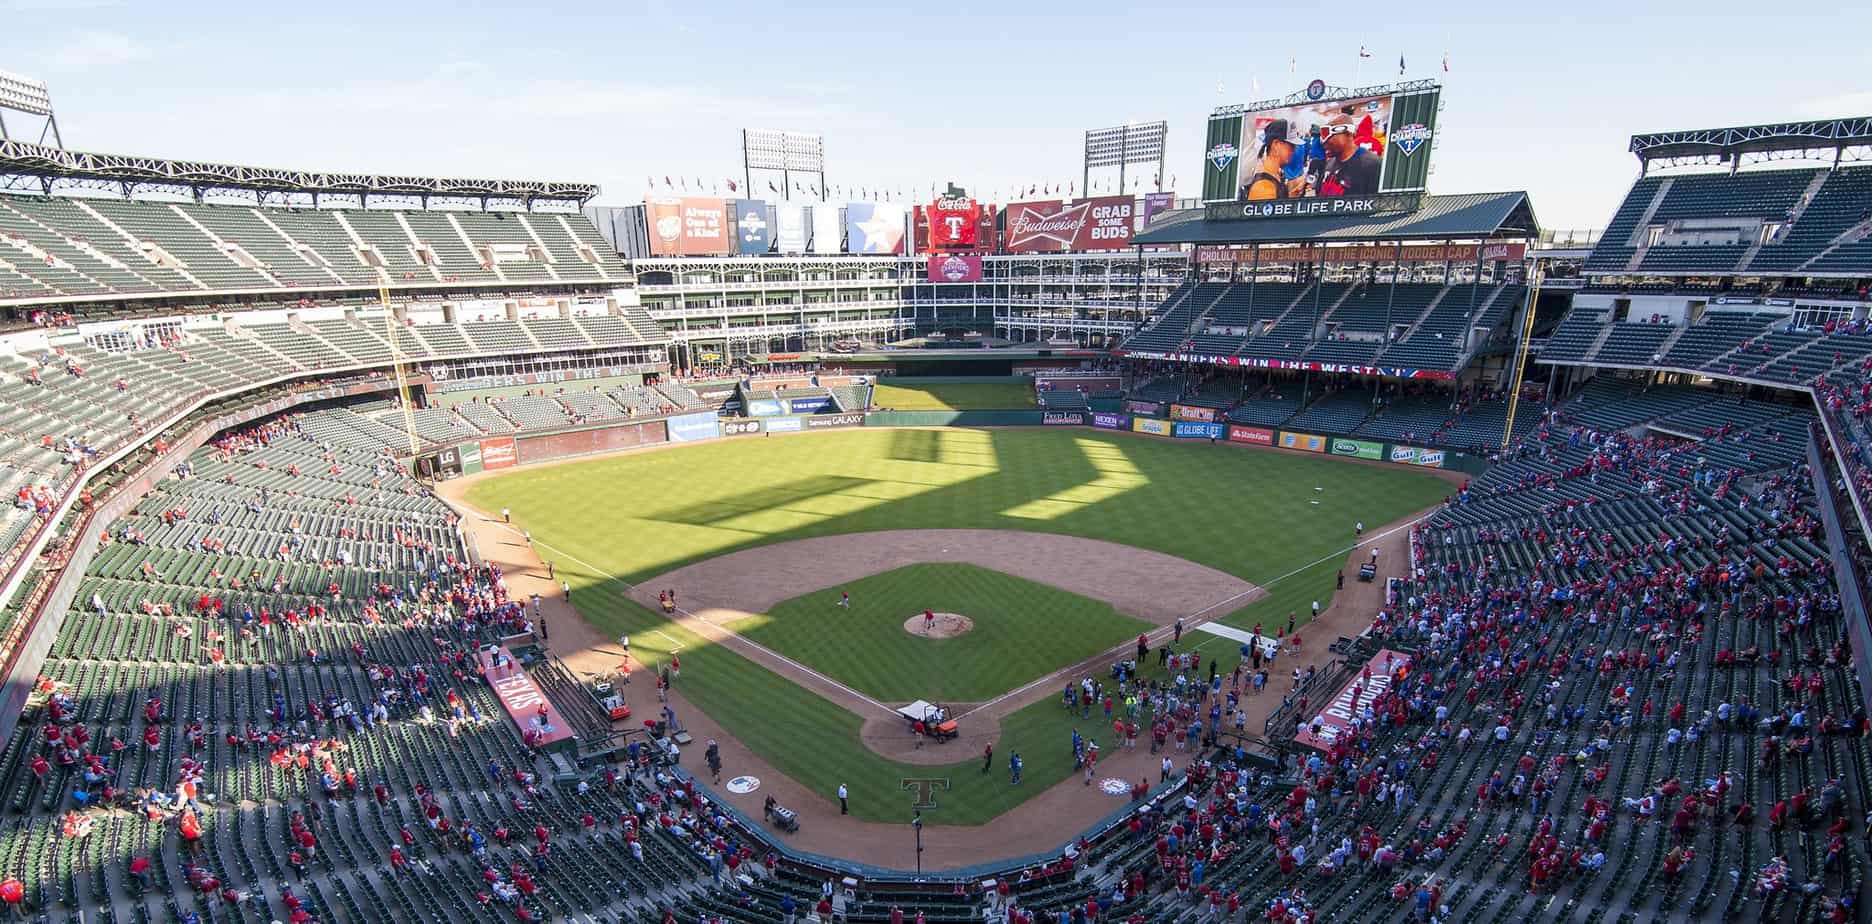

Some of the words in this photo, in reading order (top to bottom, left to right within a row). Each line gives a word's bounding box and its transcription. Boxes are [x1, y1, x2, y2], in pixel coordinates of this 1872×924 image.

[937, 196, 972, 211] Coca-Cola
[1243, 203, 1292, 217] GLOBE
[1297, 201, 1328, 214] LIFE
[1333, 199, 1374, 212] PARK
[685, 208, 720, 219] Always
[1091, 205, 1131, 219] GRAB
[686, 218, 706, 227] One
[945, 216, 963, 239] T
[1010, 216, 1086, 234] Budweiser
[1098, 218, 1124, 227] SOME
[695, 228, 720, 237] Kind
[1091, 226, 1129, 240] BUDS
[1201, 250, 1237, 262] CHOLULA
[1240, 250, 1257, 261] THE
[1259, 249, 1275, 260] HOT
[1278, 249, 1308, 260] SAUCE
[1339, 248, 1359, 259] THE
[1360, 248, 1394, 259] ICONIC
[1448, 247, 1471, 258] CAP
[1239, 358, 1268, 368] WIN
[1281, 361, 1310, 370] THE
[1321, 363, 1374, 374] WEST
[536, 371, 566, 383] WIN
[832, 415, 863, 425] GALAXY
[1096, 416, 1117, 425] NEXEN
[1184, 424, 1207, 435] GLOBE
[1337, 443, 1355, 451] Scotts
[440, 451, 454, 465] LG
[1393, 450, 1415, 460] Gulf
[1421, 454, 1441, 463] Gulf
[496, 674, 543, 710] TEXAS
[901, 778, 949, 808] T
